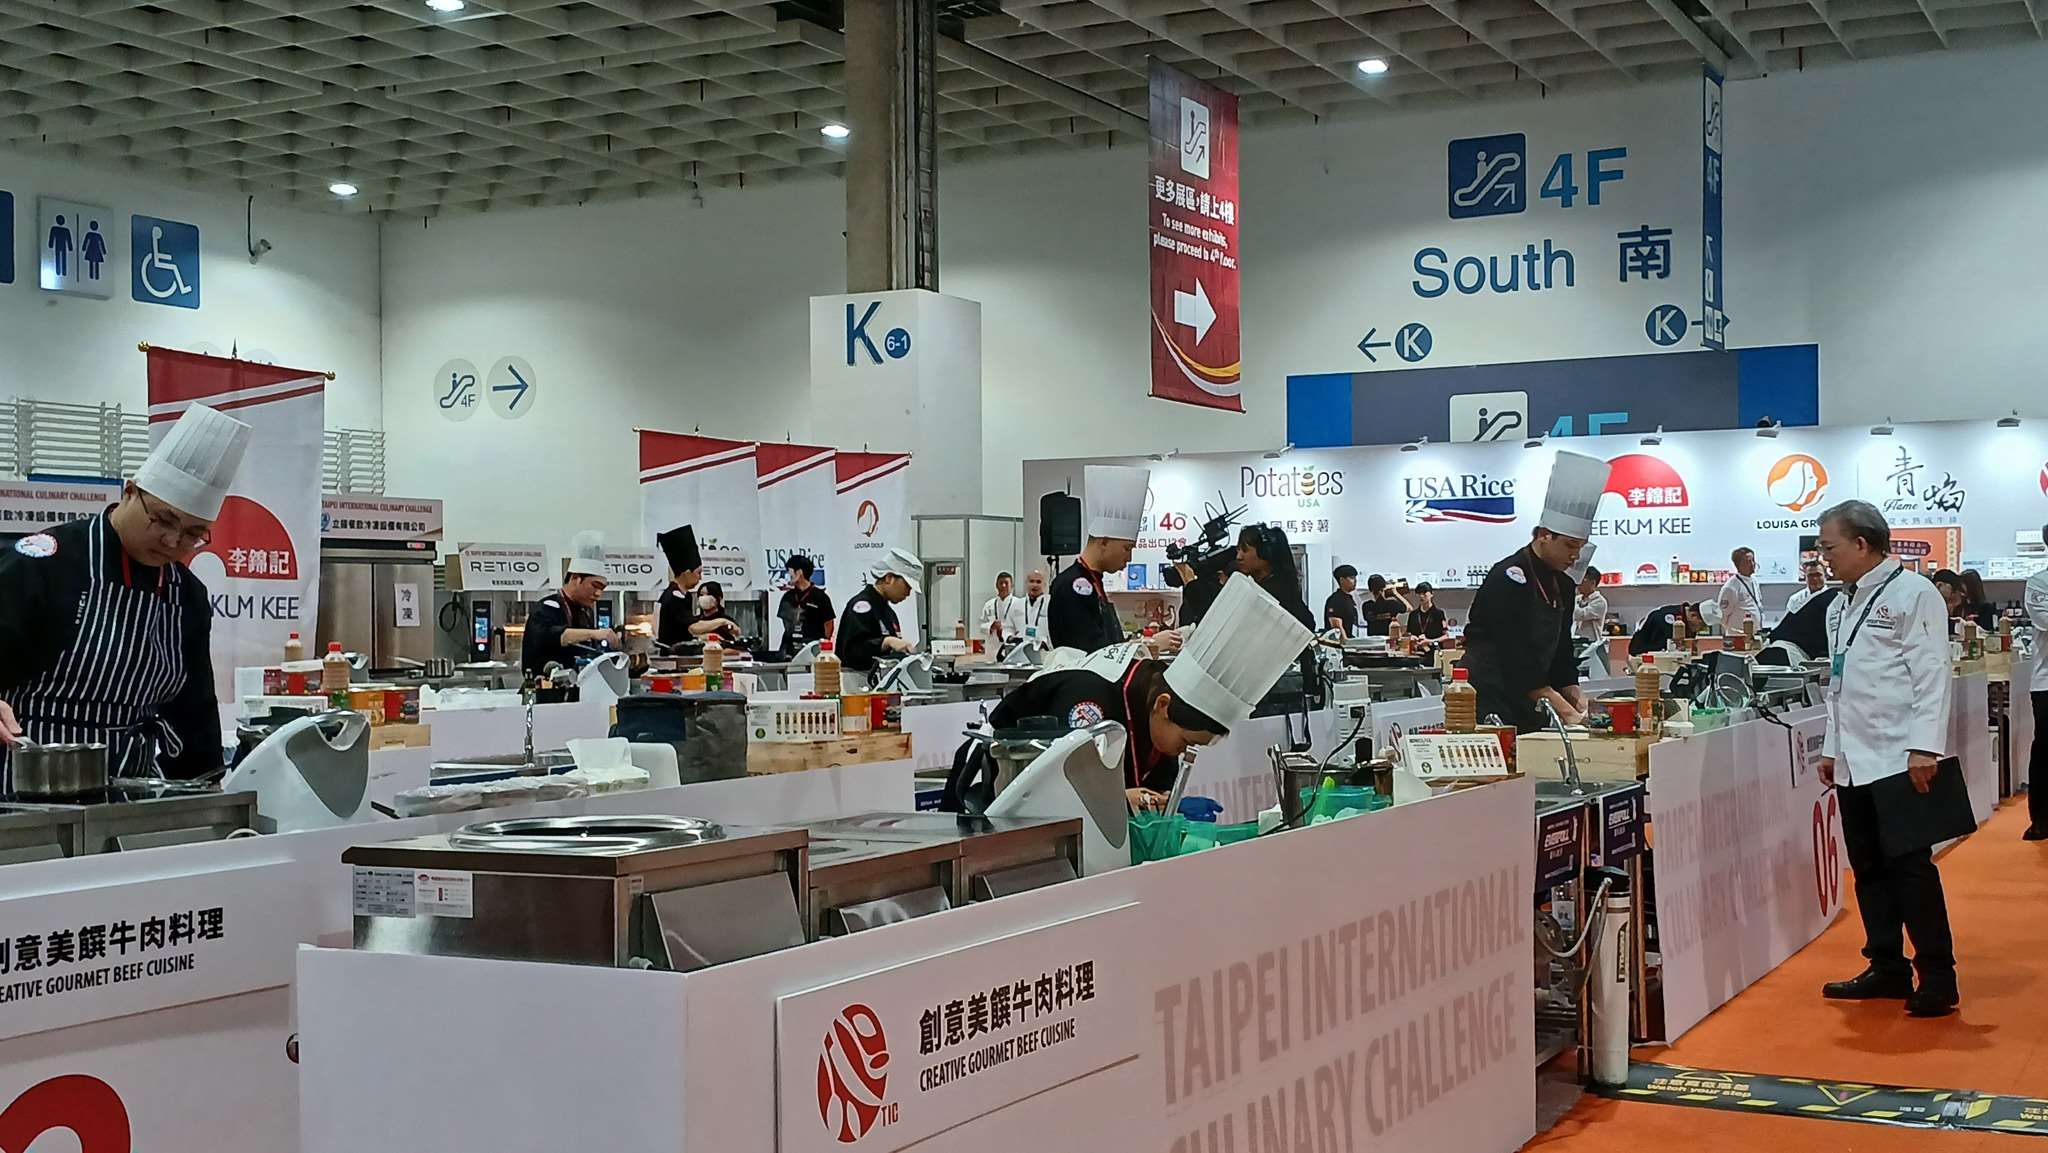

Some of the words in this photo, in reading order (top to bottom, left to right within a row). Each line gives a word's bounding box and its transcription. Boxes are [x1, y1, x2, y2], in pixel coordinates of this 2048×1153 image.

[1540, 147, 1628, 208] 4F
[1706, 156, 1720, 195] 4F
[1162, 213, 1171, 228] To
[1171, 218, 1184, 233] see
[1184, 222, 1202, 239] more
[1153, 231, 1176, 251] please
[1176, 240, 1203, 261] proceed
[1617, 225, 1672, 283] 南
[1412, 239, 1575, 299] South
[846, 302, 885, 367] K
[887, 335, 910, 352] 6-1
[1655, 310, 1681, 341] K
[1401, 328, 1427, 357] K
[460, 395, 475, 409] 4F
[1241, 466, 1343, 498] Potatoes
[1403, 476, 1457, 499] USA
[1460, 474, 1514, 497] Rice
[1627, 486, 1683, 506] 李錦記
[1297, 498, 1321, 507] USA
[1589, 520, 1609, 537] EE
[1615, 519, 1653, 536] KUM
[1659, 517, 1692, 535] KEE
[1757, 519, 1798, 530] LOUISA
[1801, 519, 1818, 529] GR
[228, 548, 290, 575] 李錦記
[470, 561, 540, 573] RETIGO
[604, 563, 653, 575] ETIGO
[702, 565, 745, 577] ETIGO
[211, 593, 253, 619] KUM
[261, 595, 299, 620] KEE
[1812, 793, 1839, 918] 06
[0, 979, 43, 1004] EATIVE
[45, 967, 111, 995] GOURMET
[113, 961, 144, 983] BEEF
[146, 953, 195, 977] CUISINE
[1155, 946, 1291, 1107] TAIPEI
[1300, 864, 1525, 1043] INTERNATIONAL
[919, 960, 1096, 1056] 創意美饌牛肉料理
[919, 1055, 967, 1092] CREATIVE
[967, 1038, 1015, 1075] GOURMET
[1016, 1030, 1040, 1059] BEEF
[1040, 1017, 1076, 1049] CUISINE
[1364, 970, 1518, 1137] CHALLENGE
[1689, 1087, 1720, 1096] your
[1722, 1089, 1752, 1098] step
[881, 1102, 899, 1128] TIC
